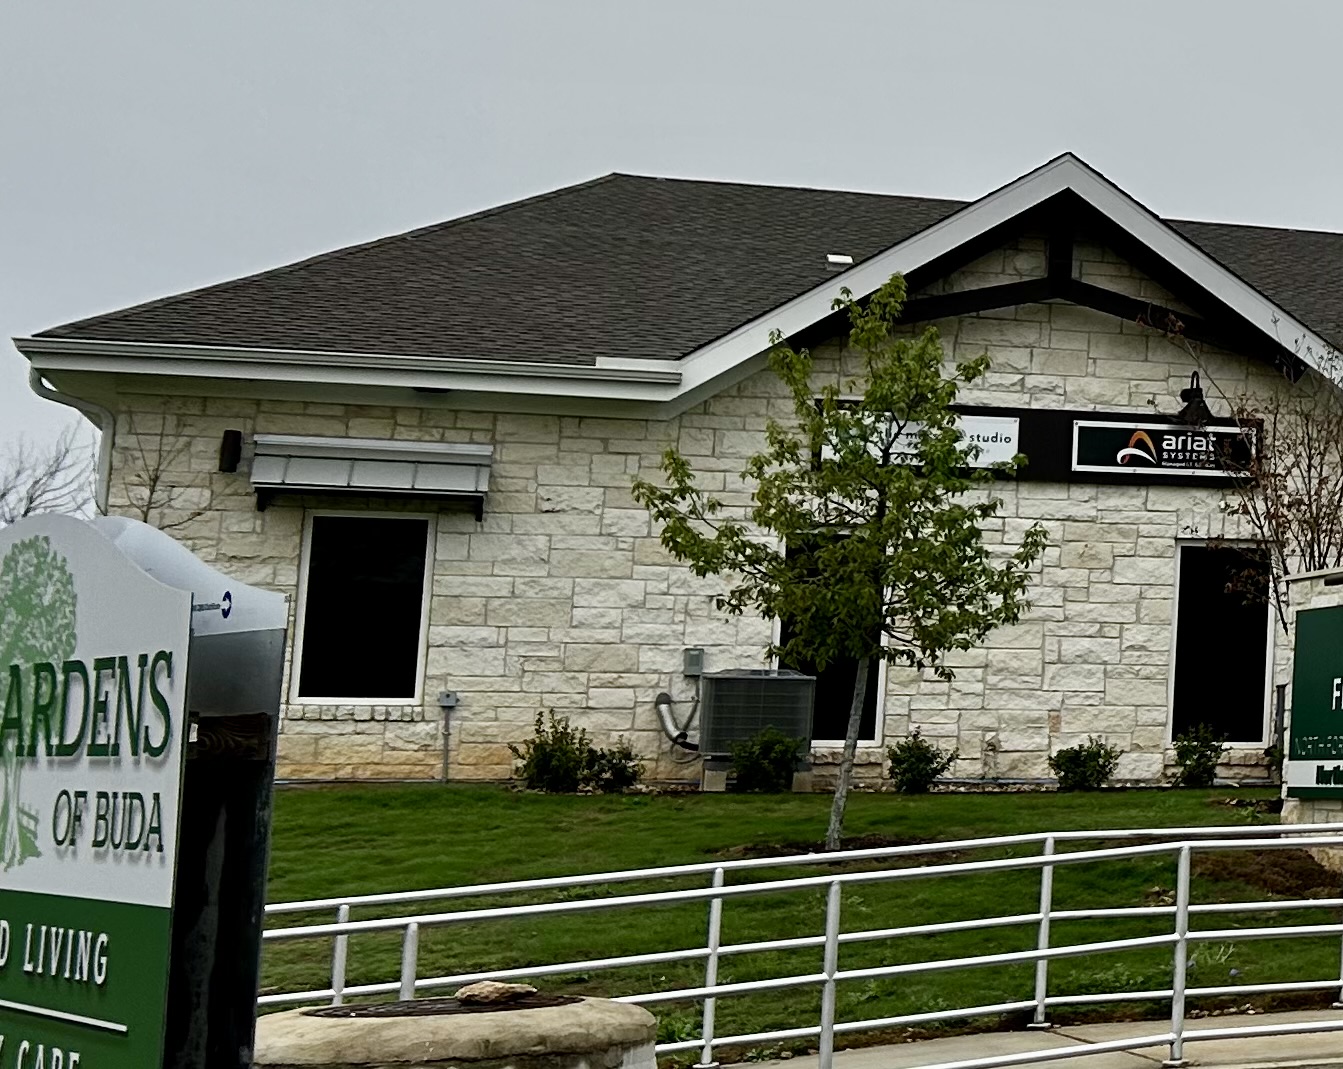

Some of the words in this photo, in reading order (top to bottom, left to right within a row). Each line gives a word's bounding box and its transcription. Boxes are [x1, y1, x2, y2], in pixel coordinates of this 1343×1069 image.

[969, 432, 1012, 444] studio
[1162, 432, 1216, 451] ariat
[0, 650, 172, 757] ARDENS
[52, 789, 88, 847] OF
[92, 791, 164, 853] BUDA
[23, 923, 108, 984] LIVING
